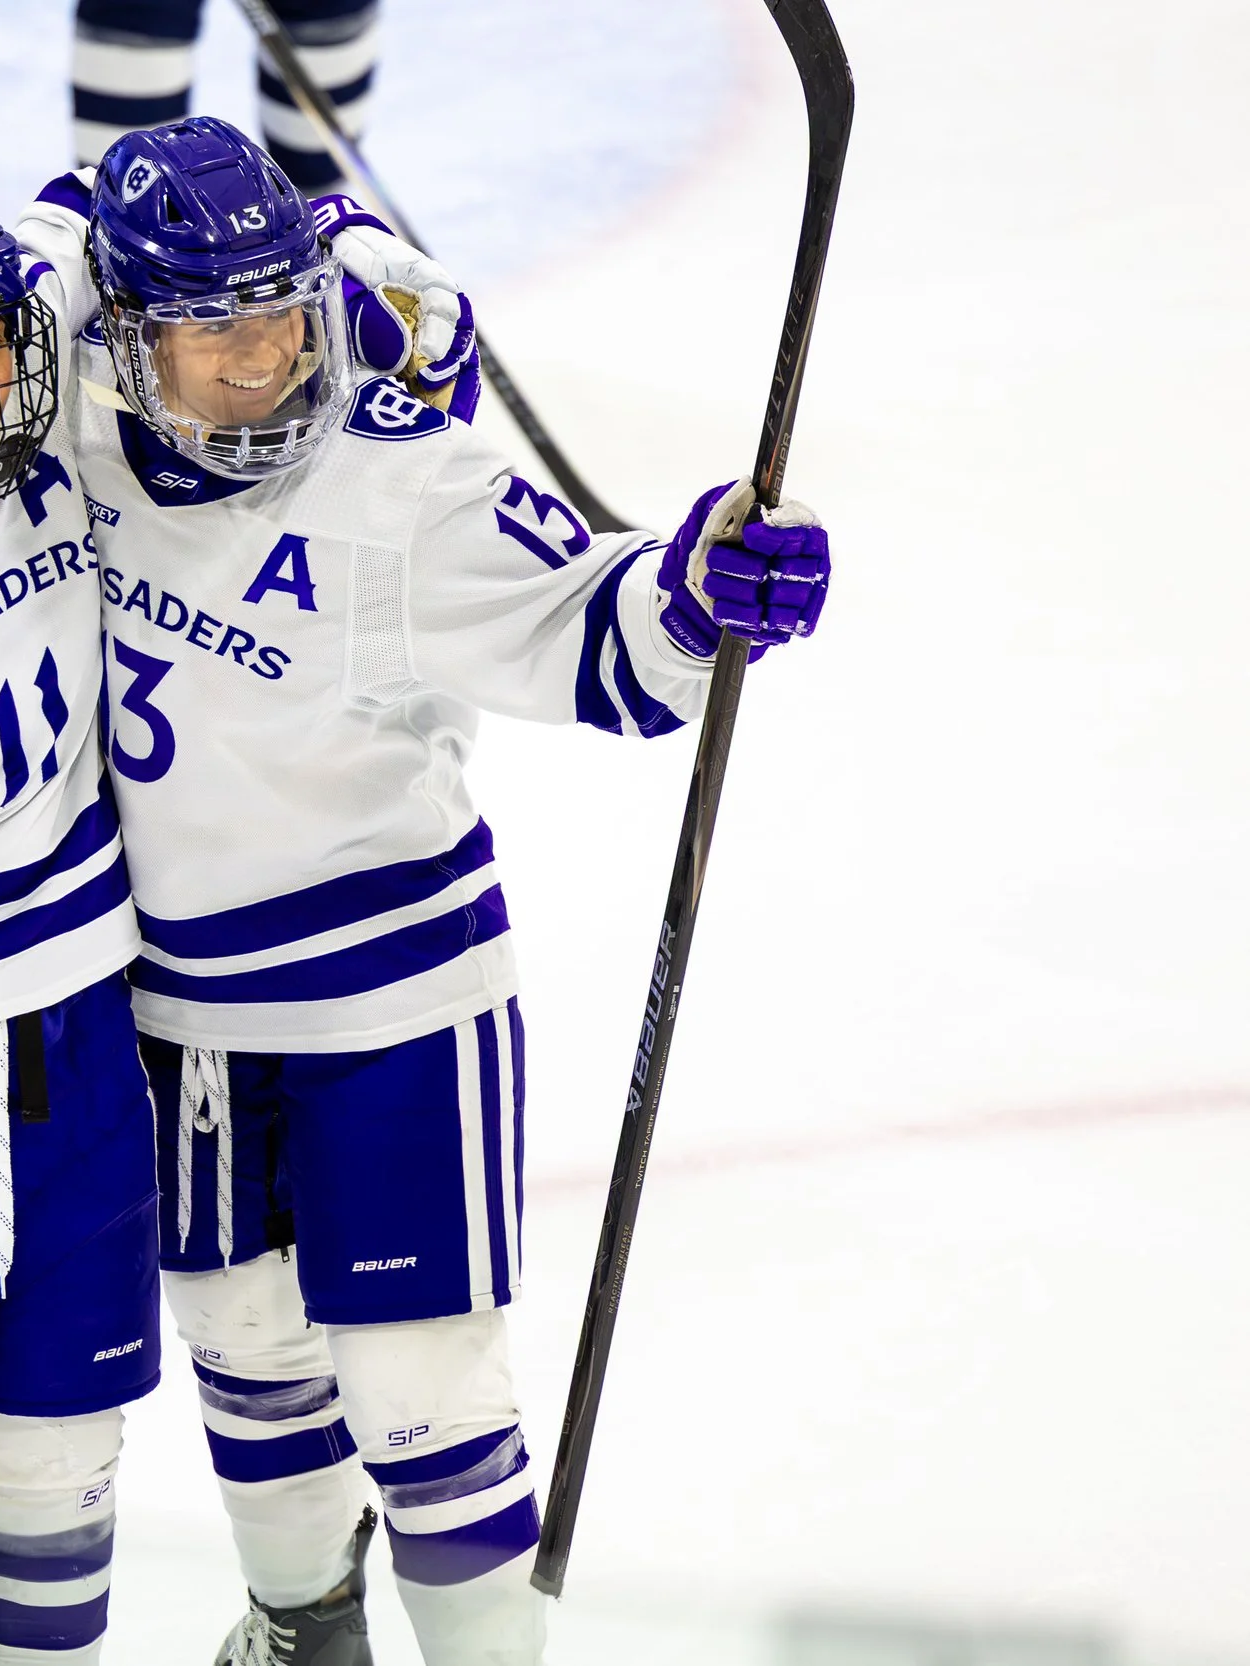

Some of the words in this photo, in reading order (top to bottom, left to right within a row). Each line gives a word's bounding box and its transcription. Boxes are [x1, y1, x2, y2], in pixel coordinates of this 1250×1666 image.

[228, 204, 268, 236] 13
[96, 229, 129, 266] BAUER
[226, 259, 292, 286] BAUER
[127, 330, 146, 402] CRUSADE
[150, 471, 198, 491] SP
[84, 500, 118, 522] CKEY
[495, 473, 590, 571] 13
[242, 532, 319, 613] A
[101, 567, 293, 681] SADERS
[668, 616, 707, 655] BAUER
[634, 920, 676, 1088] BAUER
[634, 1149, 649, 1189] TWITCH
[644, 1112, 656, 1147] TAPER
[351, 1256, 418, 1273] BAUER
[92, 1338, 143, 1362] BAUER
[386, 1423, 432, 1447] SP
[81, 1479, 111, 1510] SP
